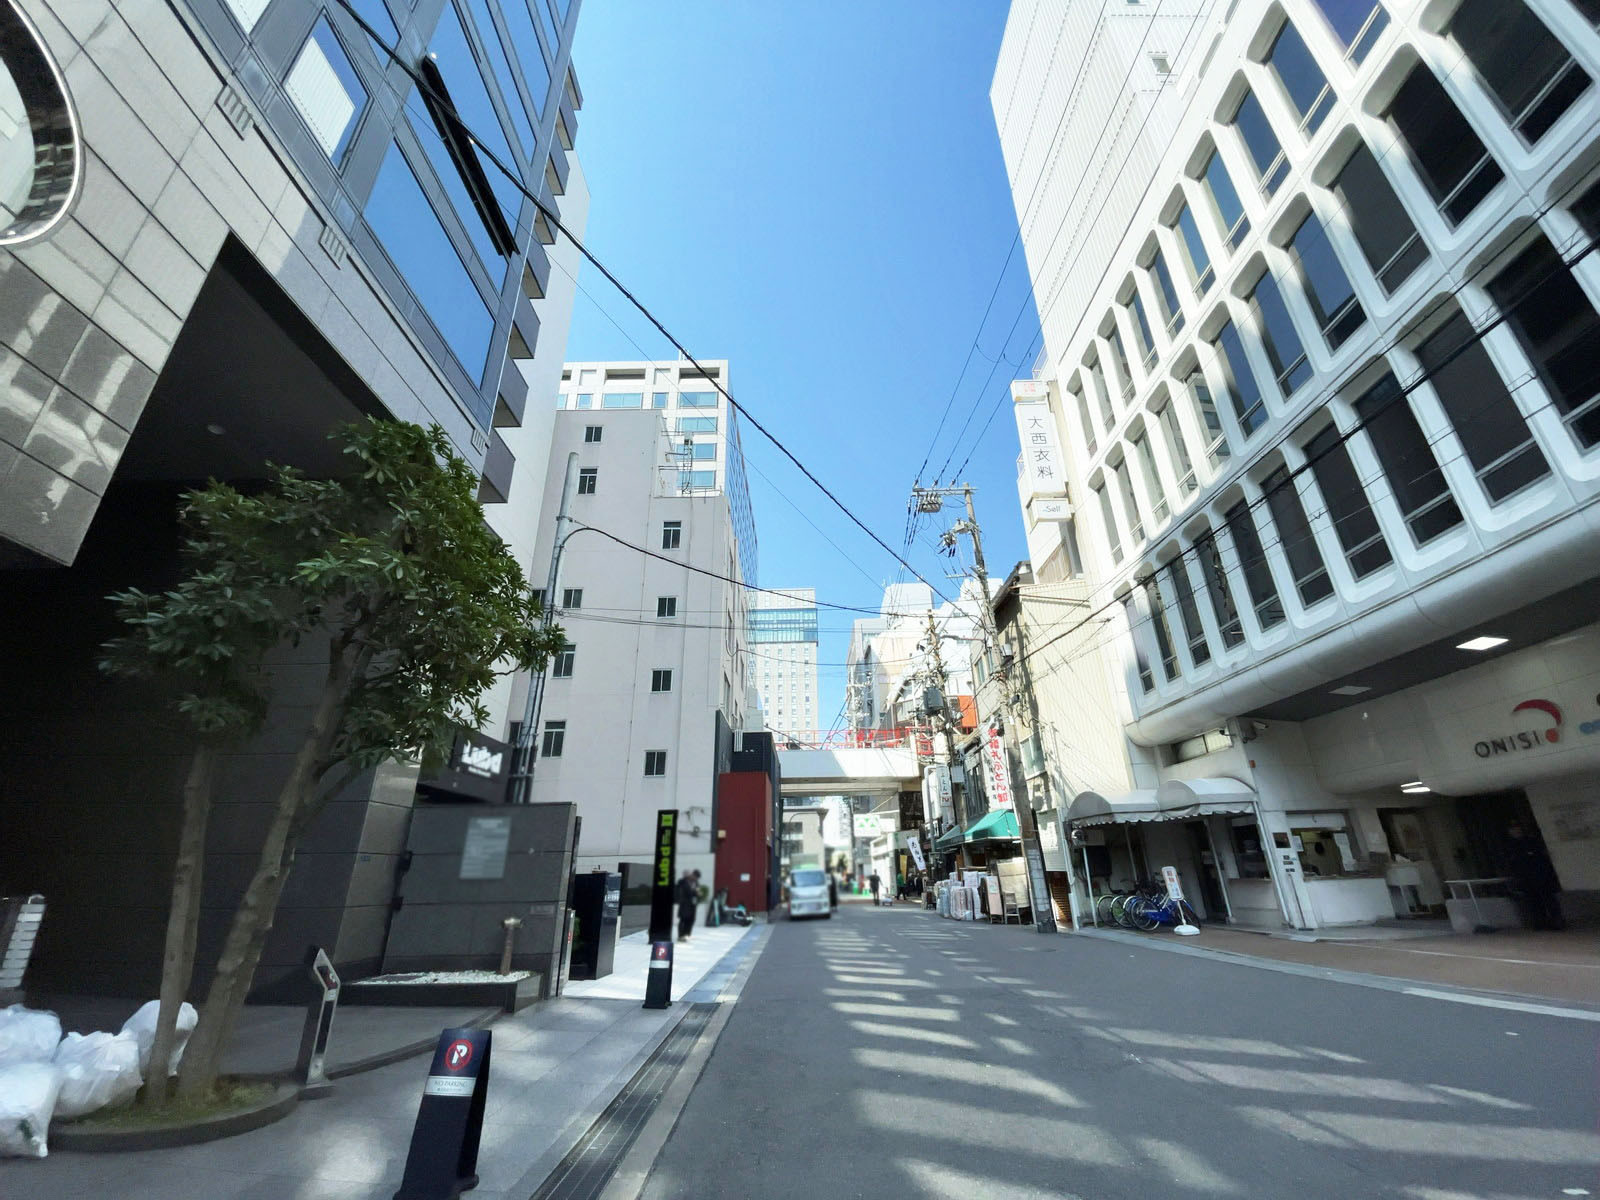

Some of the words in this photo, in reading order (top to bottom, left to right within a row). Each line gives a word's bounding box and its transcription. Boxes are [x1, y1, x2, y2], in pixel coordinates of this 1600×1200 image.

[1027, 416, 1053, 480] 大西衣料
[1474, 730, 1541, 758] ONISI
